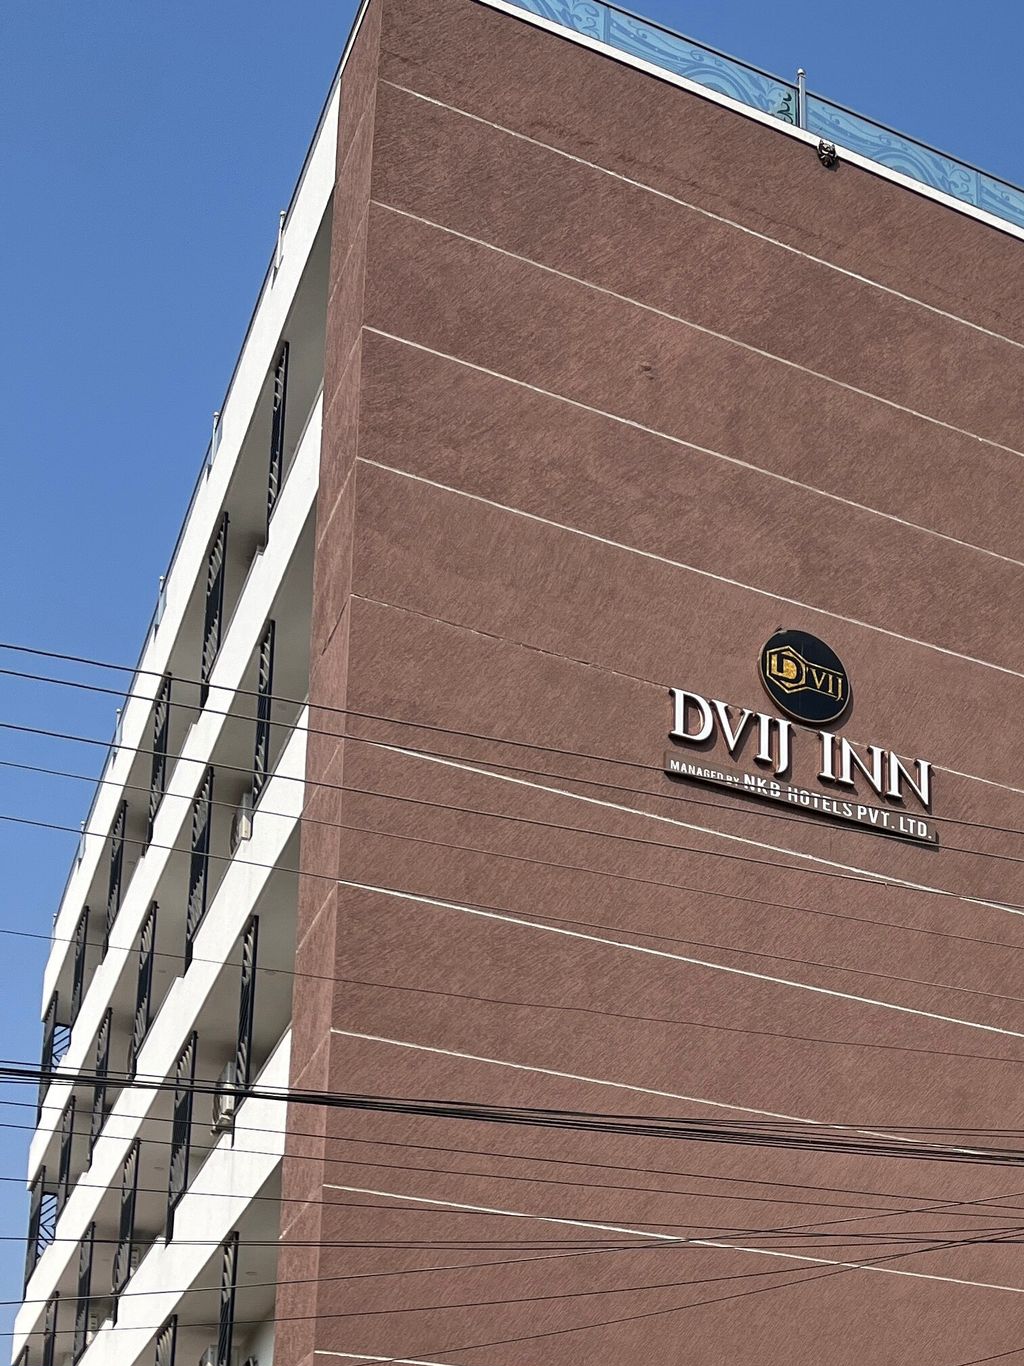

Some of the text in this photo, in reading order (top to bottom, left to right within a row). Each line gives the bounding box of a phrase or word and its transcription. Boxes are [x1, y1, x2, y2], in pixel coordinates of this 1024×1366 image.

[669, 688, 932, 806] DVIJ INN
[670, 759, 724, 780] MANAGED
[726, 774, 739, 787] BY
[787, 786, 853, 817] HOTELS
[857, 805, 896, 829] PVT.
[899, 816, 932, 839] LTD.
